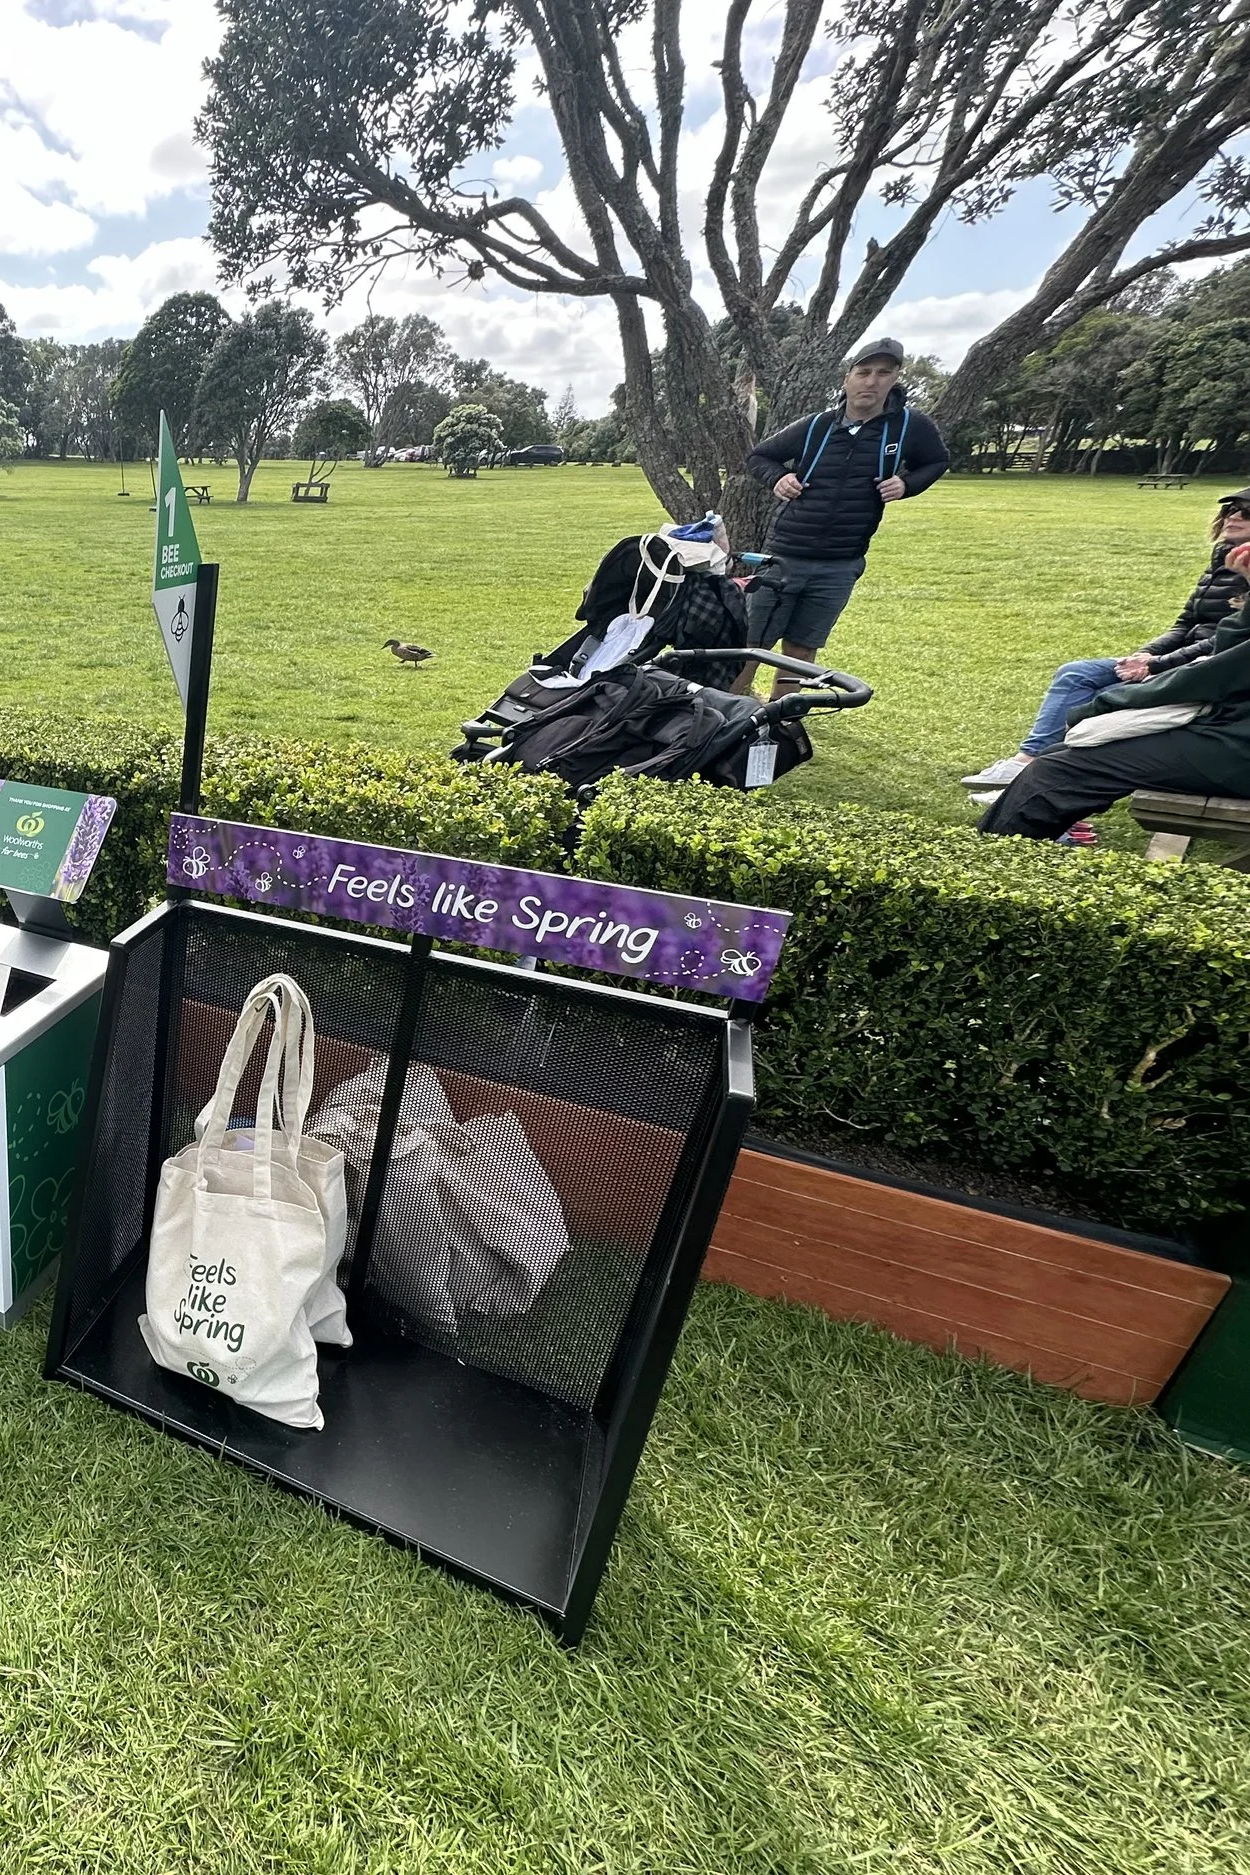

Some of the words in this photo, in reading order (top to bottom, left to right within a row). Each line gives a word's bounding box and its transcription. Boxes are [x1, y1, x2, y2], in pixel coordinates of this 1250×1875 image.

[164, 486, 176, 537] 1
[161, 543, 180, 565] BEE
[160, 562, 194, 579] CHECKOUT
[1, 846, 12, 856] for
[327, 863, 415, 909] Feels
[431, 882, 498, 923] like
[511, 895, 660, 964] Spring
[187, 1283, 227, 1313] like
[173, 1297, 245, 1353] Spring
